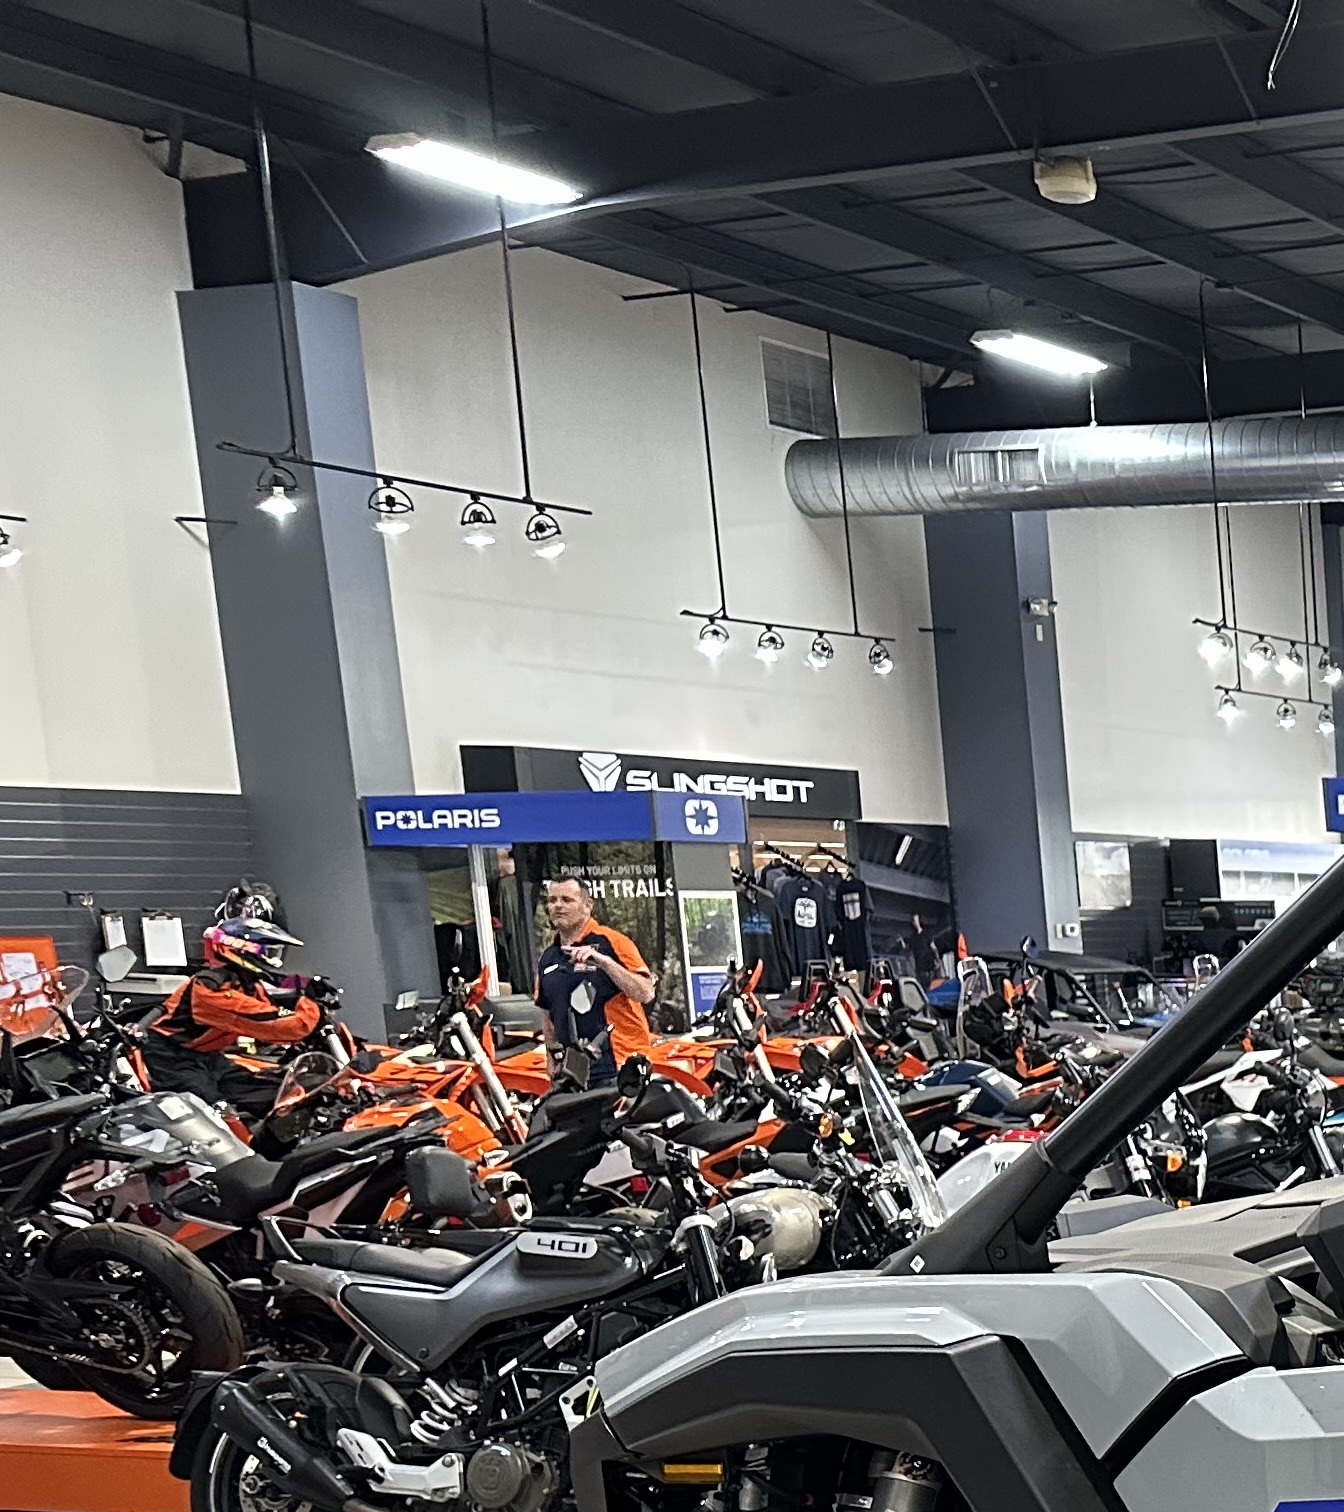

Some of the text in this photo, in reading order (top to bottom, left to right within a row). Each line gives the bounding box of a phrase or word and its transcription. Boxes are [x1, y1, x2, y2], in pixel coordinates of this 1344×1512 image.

[626, 769, 814, 803] SLINGSHOT
[375, 808, 500, 830] POLARIS
[561, 865, 585, 876] PUSH
[587, 865, 610, 876] YOUR
[609, 877, 674, 898] TRAILS
[537, 1238, 587, 1254] 401
